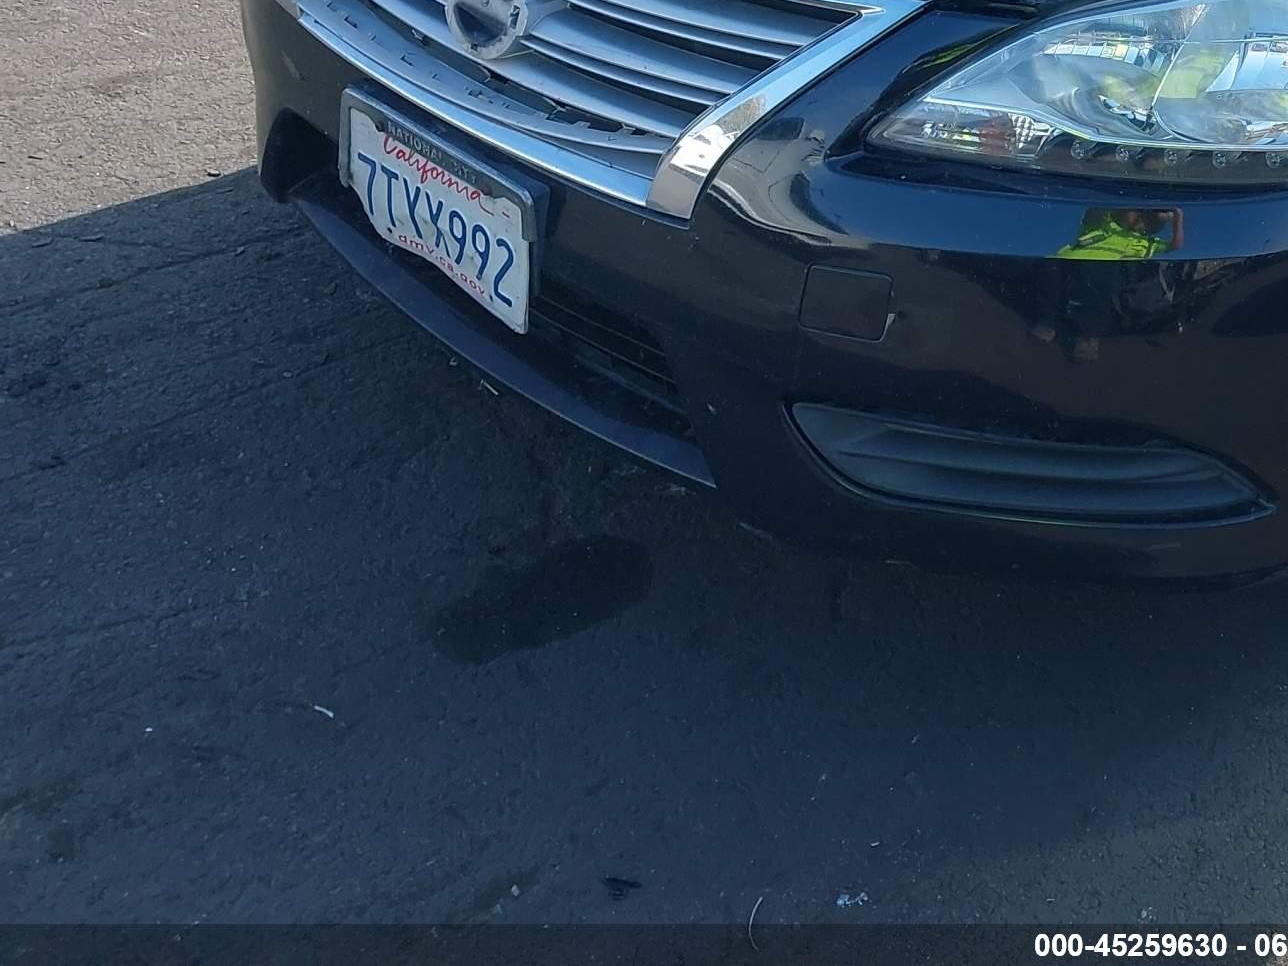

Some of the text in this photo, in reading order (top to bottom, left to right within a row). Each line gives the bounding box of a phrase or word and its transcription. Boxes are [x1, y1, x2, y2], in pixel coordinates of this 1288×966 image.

[383, 135, 494, 216] California
[358, 152, 513, 307] 7TYX992
[398, 235, 486, 295] dmv.ca.gov
